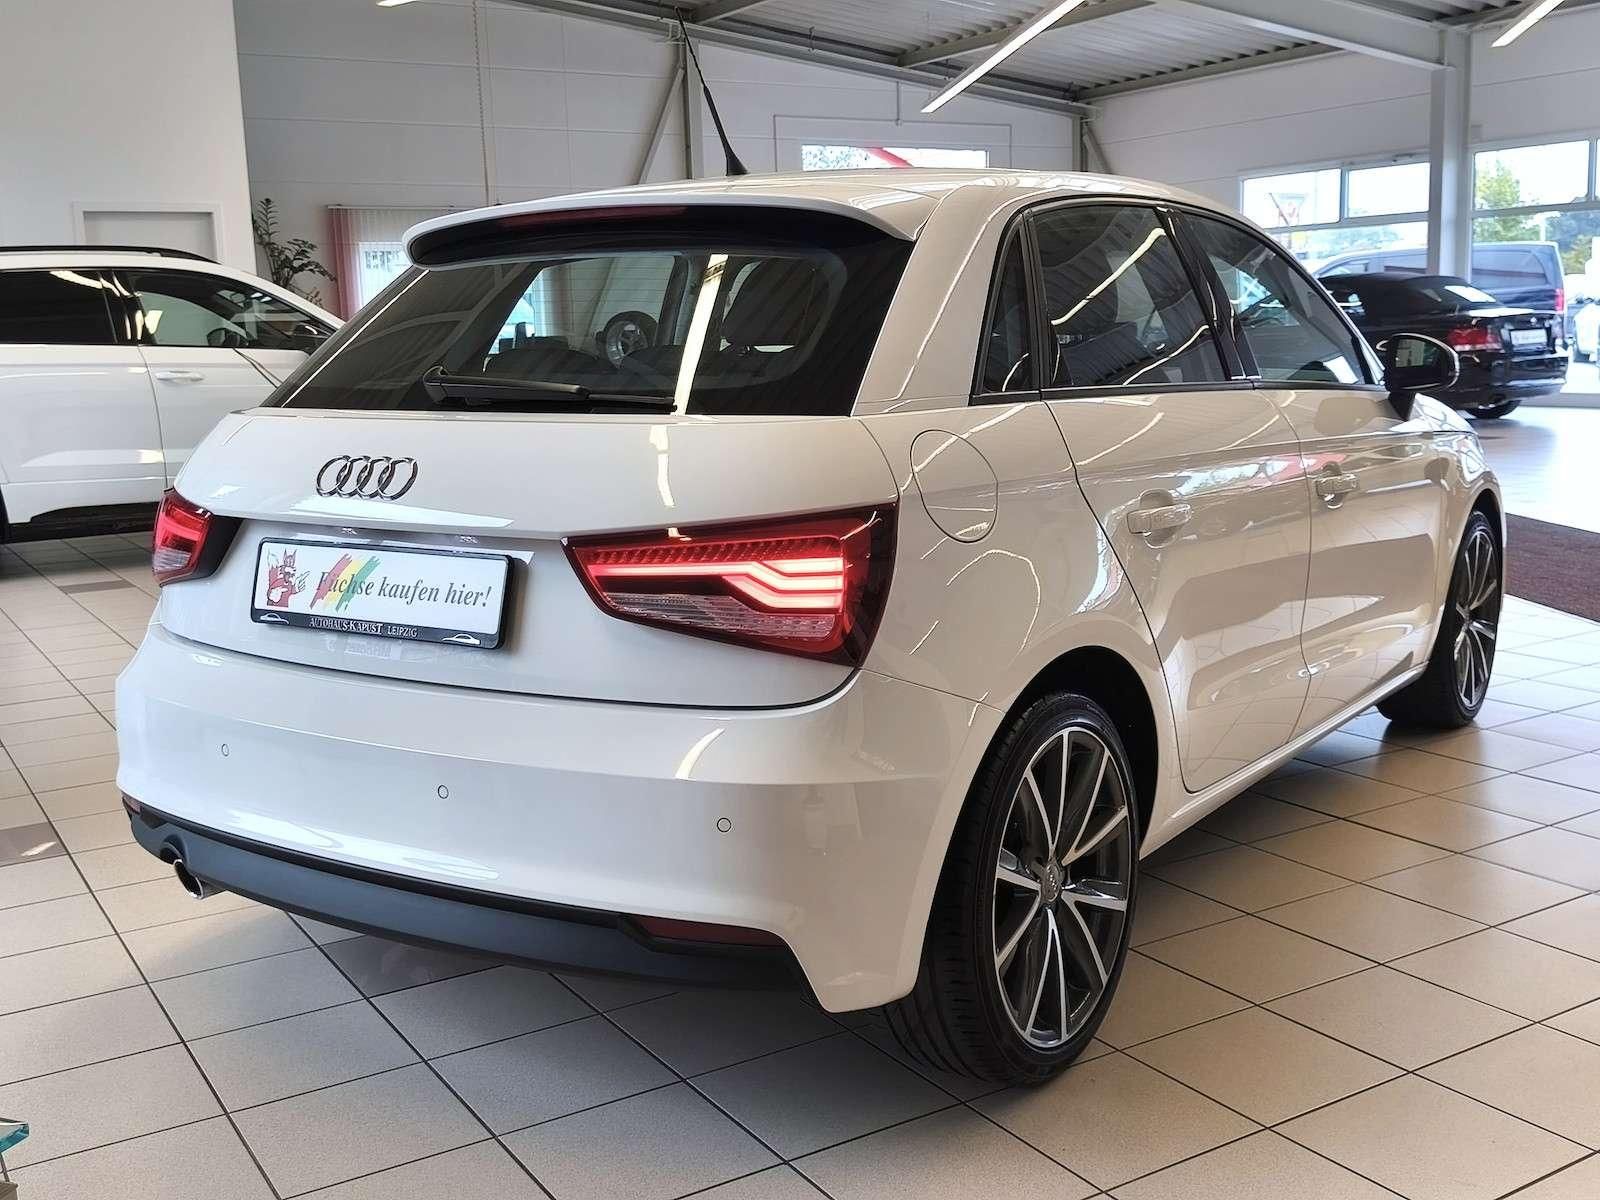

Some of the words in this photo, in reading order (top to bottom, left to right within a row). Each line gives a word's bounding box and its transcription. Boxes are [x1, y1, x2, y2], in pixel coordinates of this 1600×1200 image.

[377, 577, 440, 606] kaufen
[444, 582, 492, 607] hier!
[387, 626, 418, 638] LEIPZIG
